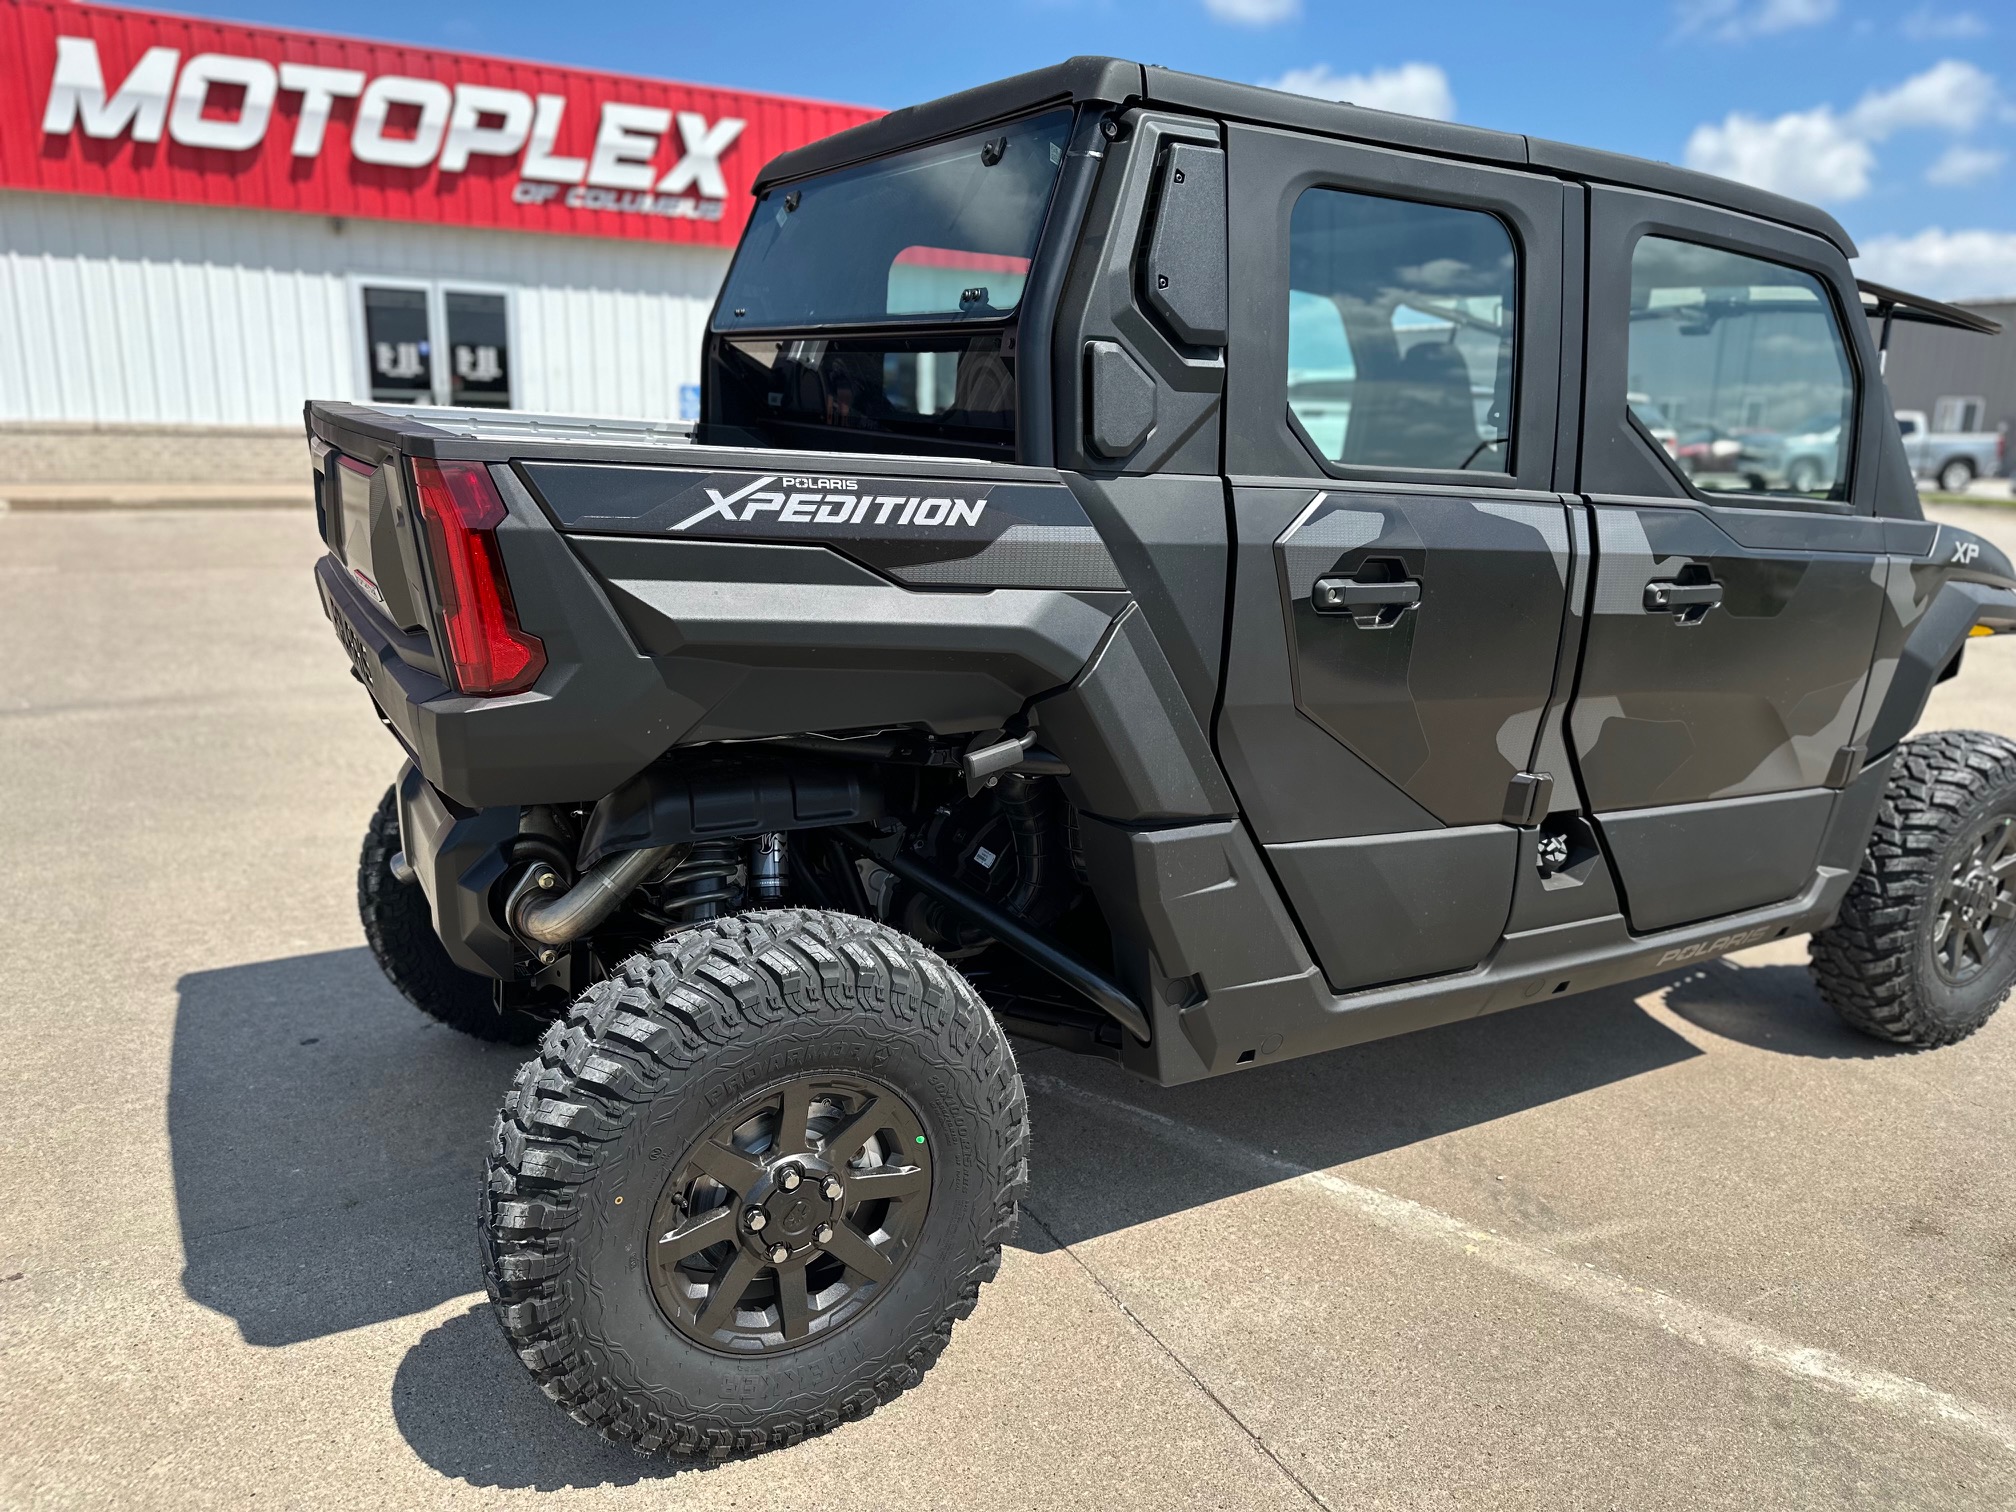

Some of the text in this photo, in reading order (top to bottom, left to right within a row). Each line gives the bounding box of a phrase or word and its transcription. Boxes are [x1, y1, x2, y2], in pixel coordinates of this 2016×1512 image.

[42, 36, 747, 198] MOTOPLEX
[512, 182, 560, 205] OF
[666, 476, 987, 530] XPEDITION
[782, 477, 858, 490] POLARIS
[1950, 541, 1980, 564] XP
[1656, 925, 1770, 966] POLARIS
[704, 1042, 867, 1108] PRO ARMOR
